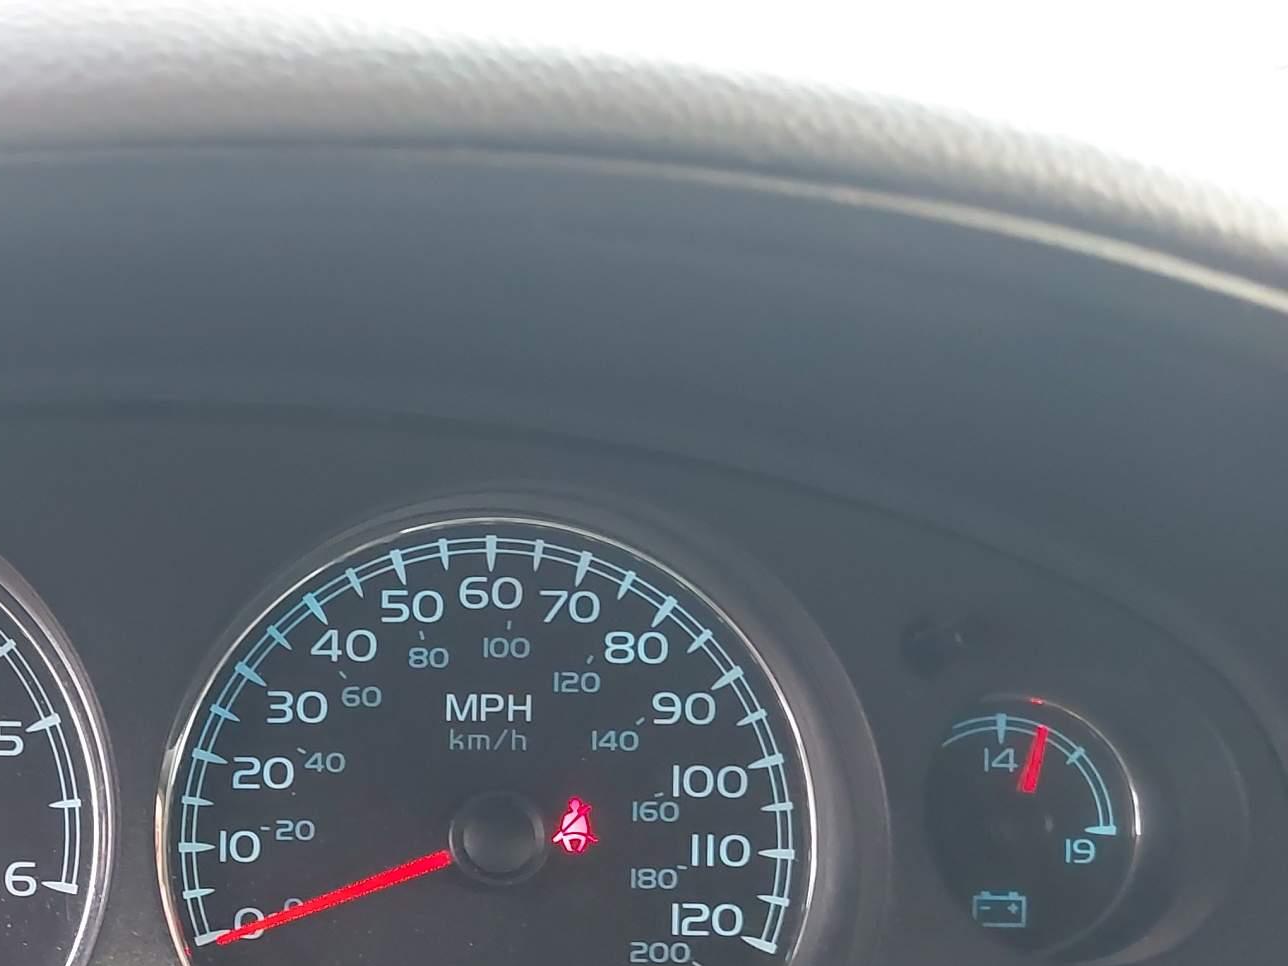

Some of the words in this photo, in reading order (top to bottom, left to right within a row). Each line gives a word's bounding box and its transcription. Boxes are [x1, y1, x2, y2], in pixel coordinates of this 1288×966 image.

[381, 589, 444, 623] 50
[459, 576, 523, 609] 60
[539, 590, 601, 623] 70
[310, 629, 377, 662] 40
[408, 647, 449, 669] 80
[483, 637, 530, 658] 100
[604, 631, 668, 664] 80
[341, 686, 382, 707] 60
[553, 671, 600, 692] 120
[266, 690, 328, 724] 30
[445, 693, 532, 722] MPH
[652, 692, 716, 725] 90
[449, 728, 527, 751] km/h
[592, 730, 639, 751] 140
[232, 756, 295, 789] 20
[304, 751, 346, 773] 40
[983, 748, 1018, 772] 14
[673, 765, 748, 798] 100
[632, 801, 679, 823] 160
[275, 819, 315, 841] 20
[219, 829, 260, 863] 10
[691, 832, 751, 867] 110
[1065, 839, 1096, 863] 19
[4, 861, 37, 897] 6
[631, 868, 678, 889] 180
[234, 907, 265, 939] 0
[672, 903, 744, 936] 120
[630, 943, 691, 964] 200
